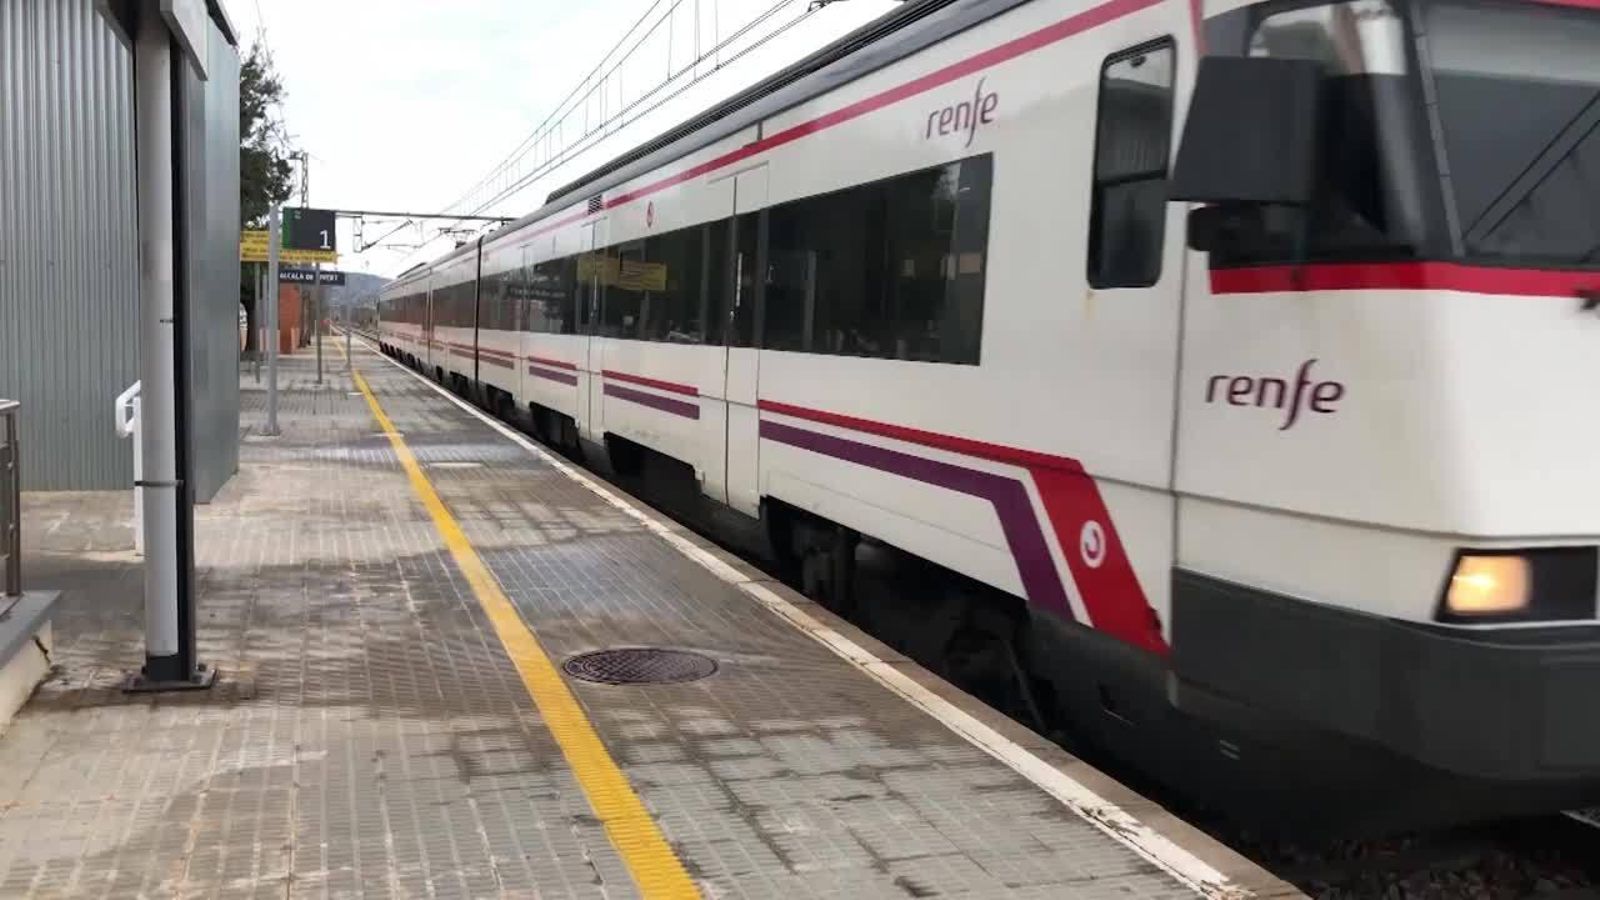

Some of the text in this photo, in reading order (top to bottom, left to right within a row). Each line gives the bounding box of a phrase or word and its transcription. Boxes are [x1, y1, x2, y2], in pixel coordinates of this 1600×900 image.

[925, 76, 998, 149] renfe
[320, 230, 331, 249] 1
[1205, 358, 1345, 430] renfe
